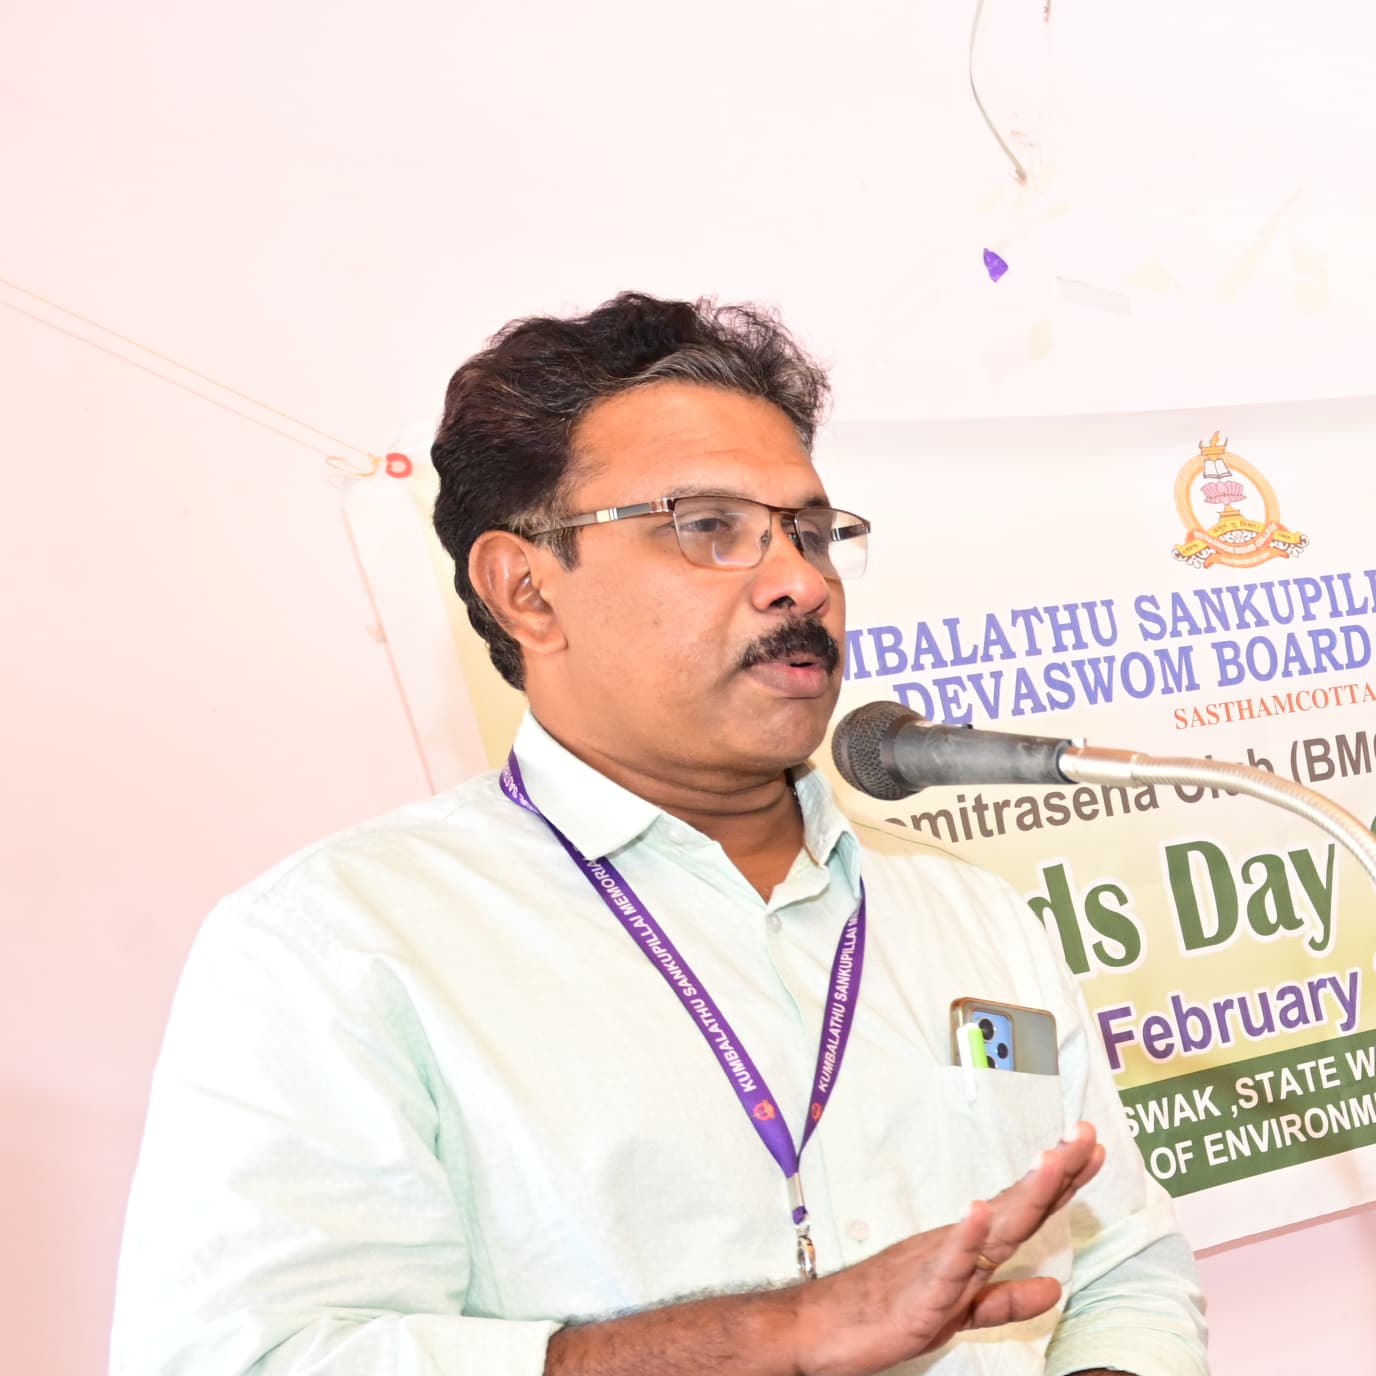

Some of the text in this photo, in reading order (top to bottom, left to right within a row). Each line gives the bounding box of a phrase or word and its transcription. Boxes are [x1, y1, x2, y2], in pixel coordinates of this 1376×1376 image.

[843, 599, 1118, 681] MBALATHU
[893, 645, 1200, 726] DEVASWOM
[1211, 623, 1372, 687] BOARD
[885, 783, 1160, 844] mitrasena
[1164, 840, 1336, 952] Day
[587, 860, 757, 1093] KUMBALATHU SANKUPILLAI MEMORIA
[818, 922, 858, 1093] KUMBALATHU SANKUPILLAI
[1097, 970, 1359, 1071] February
[1122, 1085, 1222, 1139] SWAK
[1150, 1140, 1194, 1180] OF
